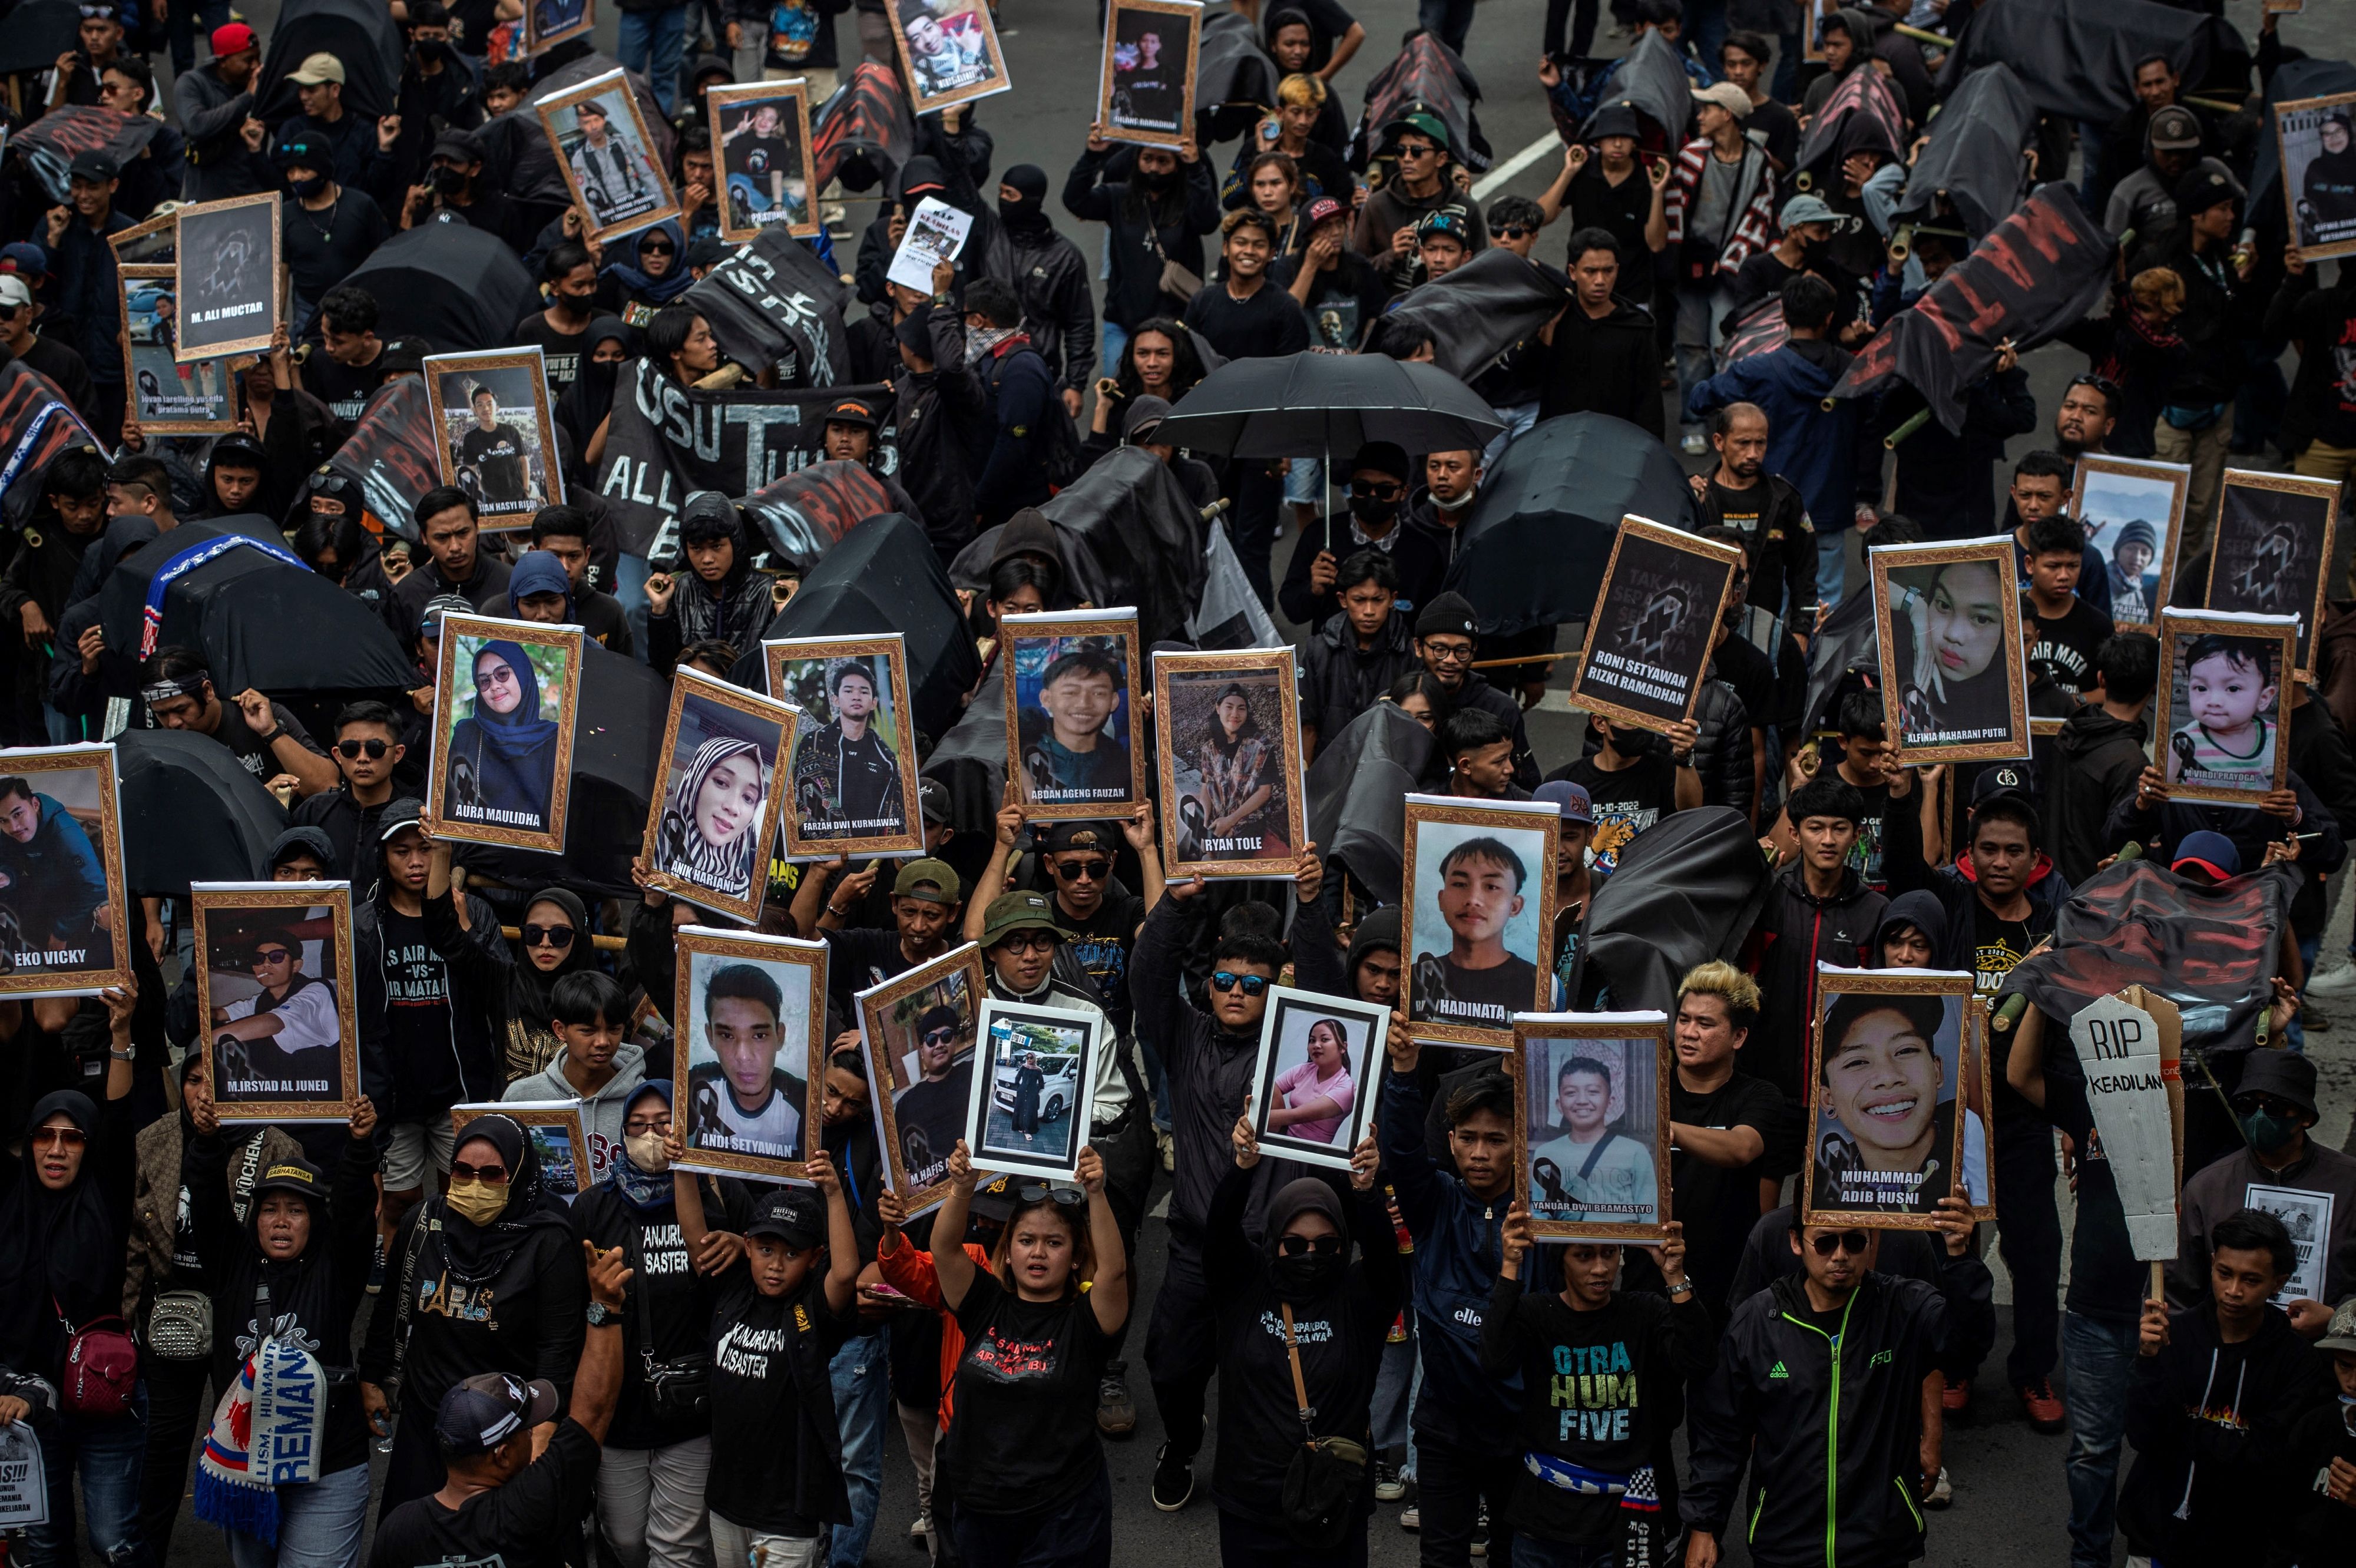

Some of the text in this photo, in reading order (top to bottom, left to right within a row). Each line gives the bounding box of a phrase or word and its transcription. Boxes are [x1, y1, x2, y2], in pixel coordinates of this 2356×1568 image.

[204, 310, 220, 322] ALI
[221, 301, 263, 319] MUCTAR
[2114, 606, 2149, 617] PRATAMA
[1594, 649, 1687, 689] RONI SETYAWAN
[1588, 665, 1685, 706] RIZKI RAMADHAN
[1908, 727, 2006, 743] ALFINIA MAHARANI PUTRI
[2218, 772, 2255, 783] PRAYOGA
[1031, 788, 1124, 799] ABDAN AGENG FAUZAN
[1592, 800, 1639, 812] 01-10-2022
[456, 804, 541, 827] AURA MAULIDHA
[803, 818, 901, 831] FARZAH DWI KURNIAWAN
[1205, 836, 1262, 852] RYAN TOLE
[670, 859, 736, 894] ANIK HARIANI
[14, 948, 87, 968] EKO VICKY
[403, 945, 425, 964] AIR
[405, 964, 435, 979] -VS-
[404, 979, 441, 997] MATA
[1440, 1000, 1505, 1020] HADINATA
[227, 1080, 329, 1093] M.IRSYAD AL JUNED
[2089, 1072, 2164, 1096] KEADILAN
[700, 1132, 792, 1159] ANDI SETYAWAN
[268, 1167, 311, 1180] SABHATANSA
[909, 1160, 945, 1186] M.HAFIS
[1841, 1170, 1923, 1185] MUHAMMAD
[1840, 1190, 1920, 1205] ADIB HUSNI
[1533, 1200, 1653, 1214] YANUAR DWI BRAMASTYO
[1454, 1308, 1482, 1326] elle
[975, 1349, 996, 1364] AIR
[1027, 1359, 1048, 1372] IBU
[1550, 1374, 1639, 1409] HUM
[1559, 1408, 1630, 1441] FIVE
